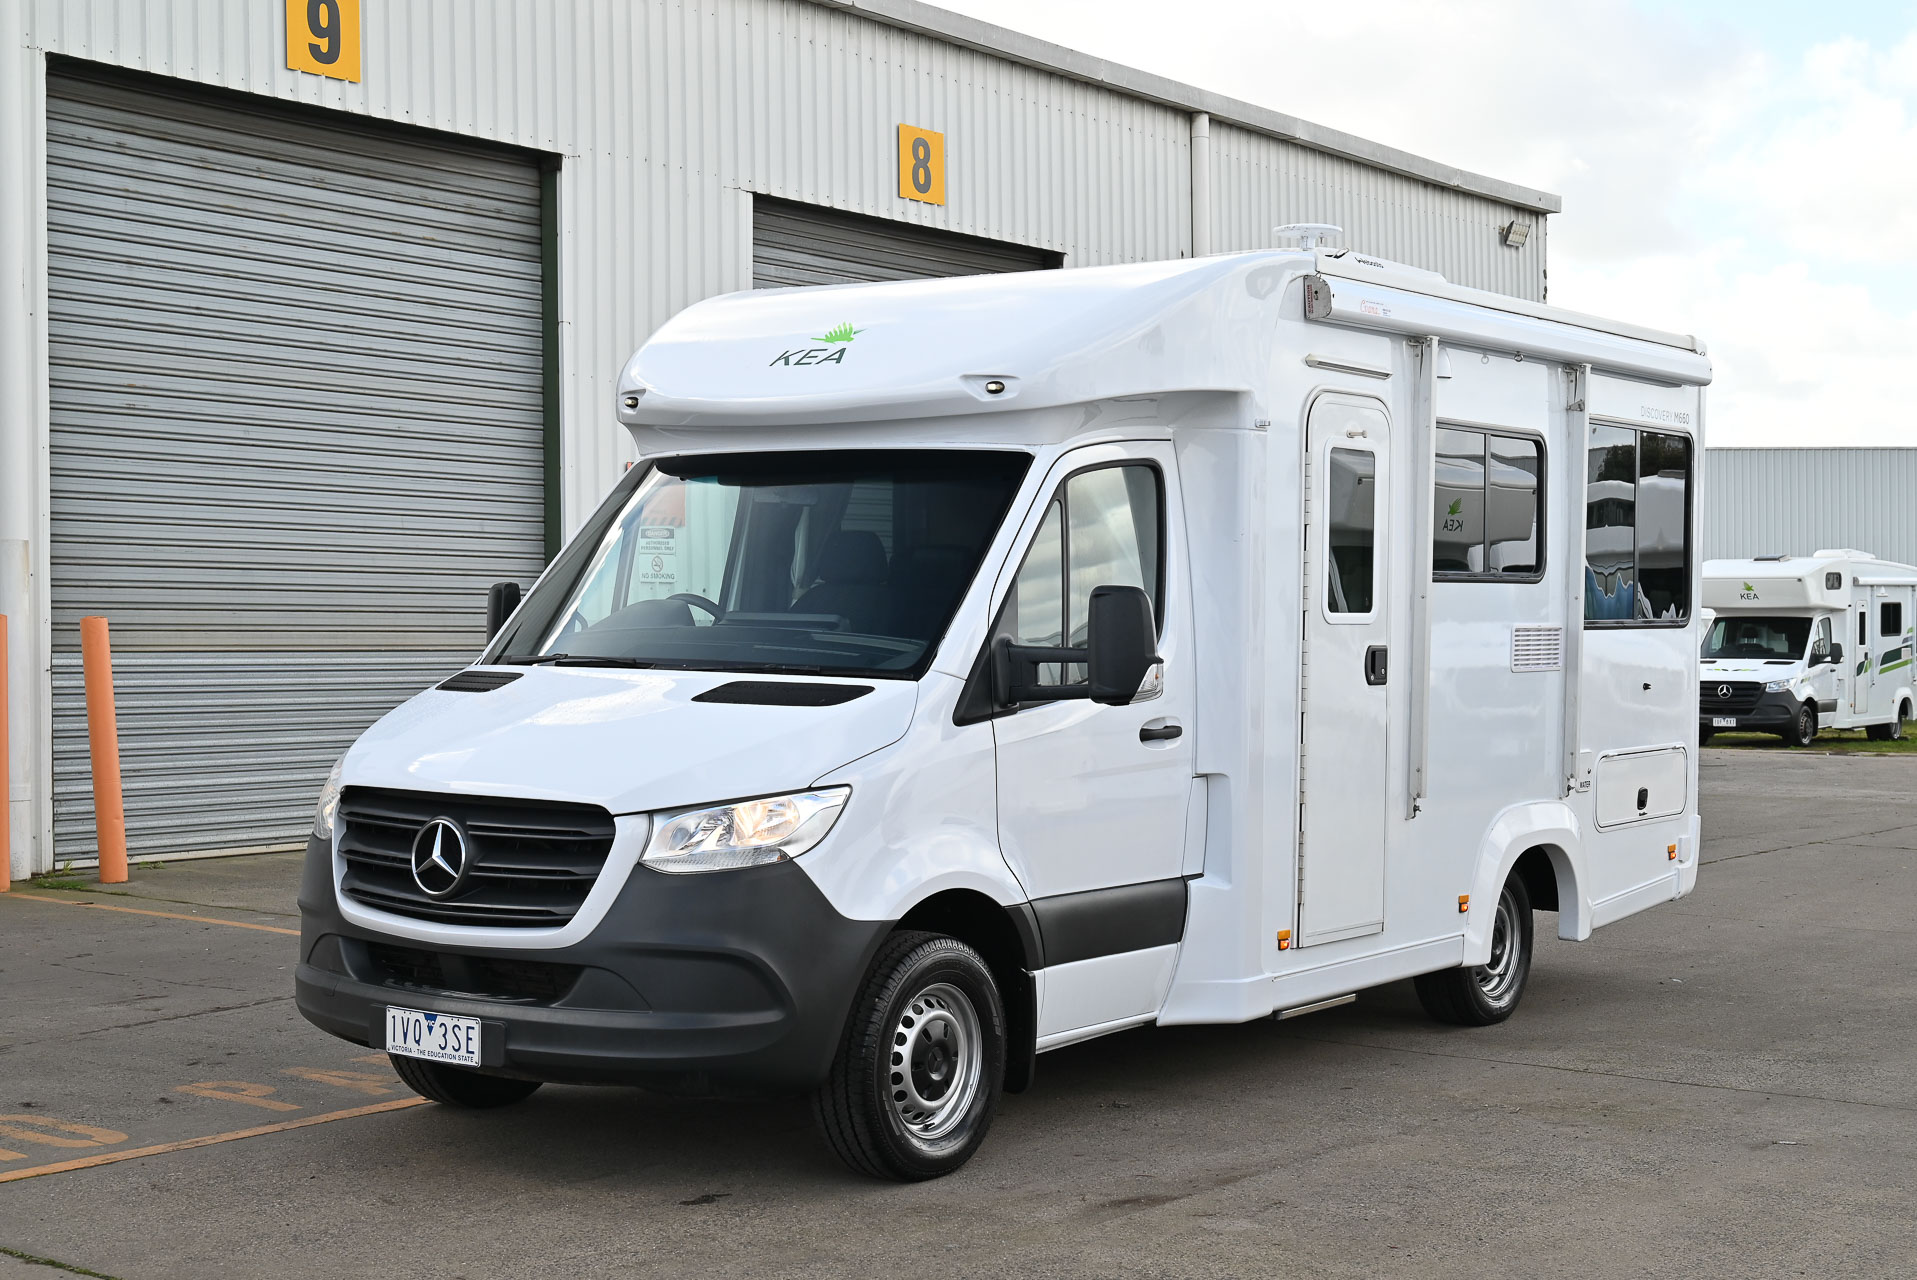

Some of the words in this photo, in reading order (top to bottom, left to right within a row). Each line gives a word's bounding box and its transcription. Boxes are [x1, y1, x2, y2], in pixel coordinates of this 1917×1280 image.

[307, 0, 341, 64] 9
[912, 137, 932, 194] 8
[769, 347, 847, 366] KEA
[1641, 406, 1673, 422] DISCOVERY
[1740, 592, 1760, 600] KEA
[391, 1045, 412, 1053] VICTORIA
[417, 1048, 426, 1056] THE
[427, 1050, 456, 1061] EDUCATION
[457, 1055, 474, 1063] STATE
